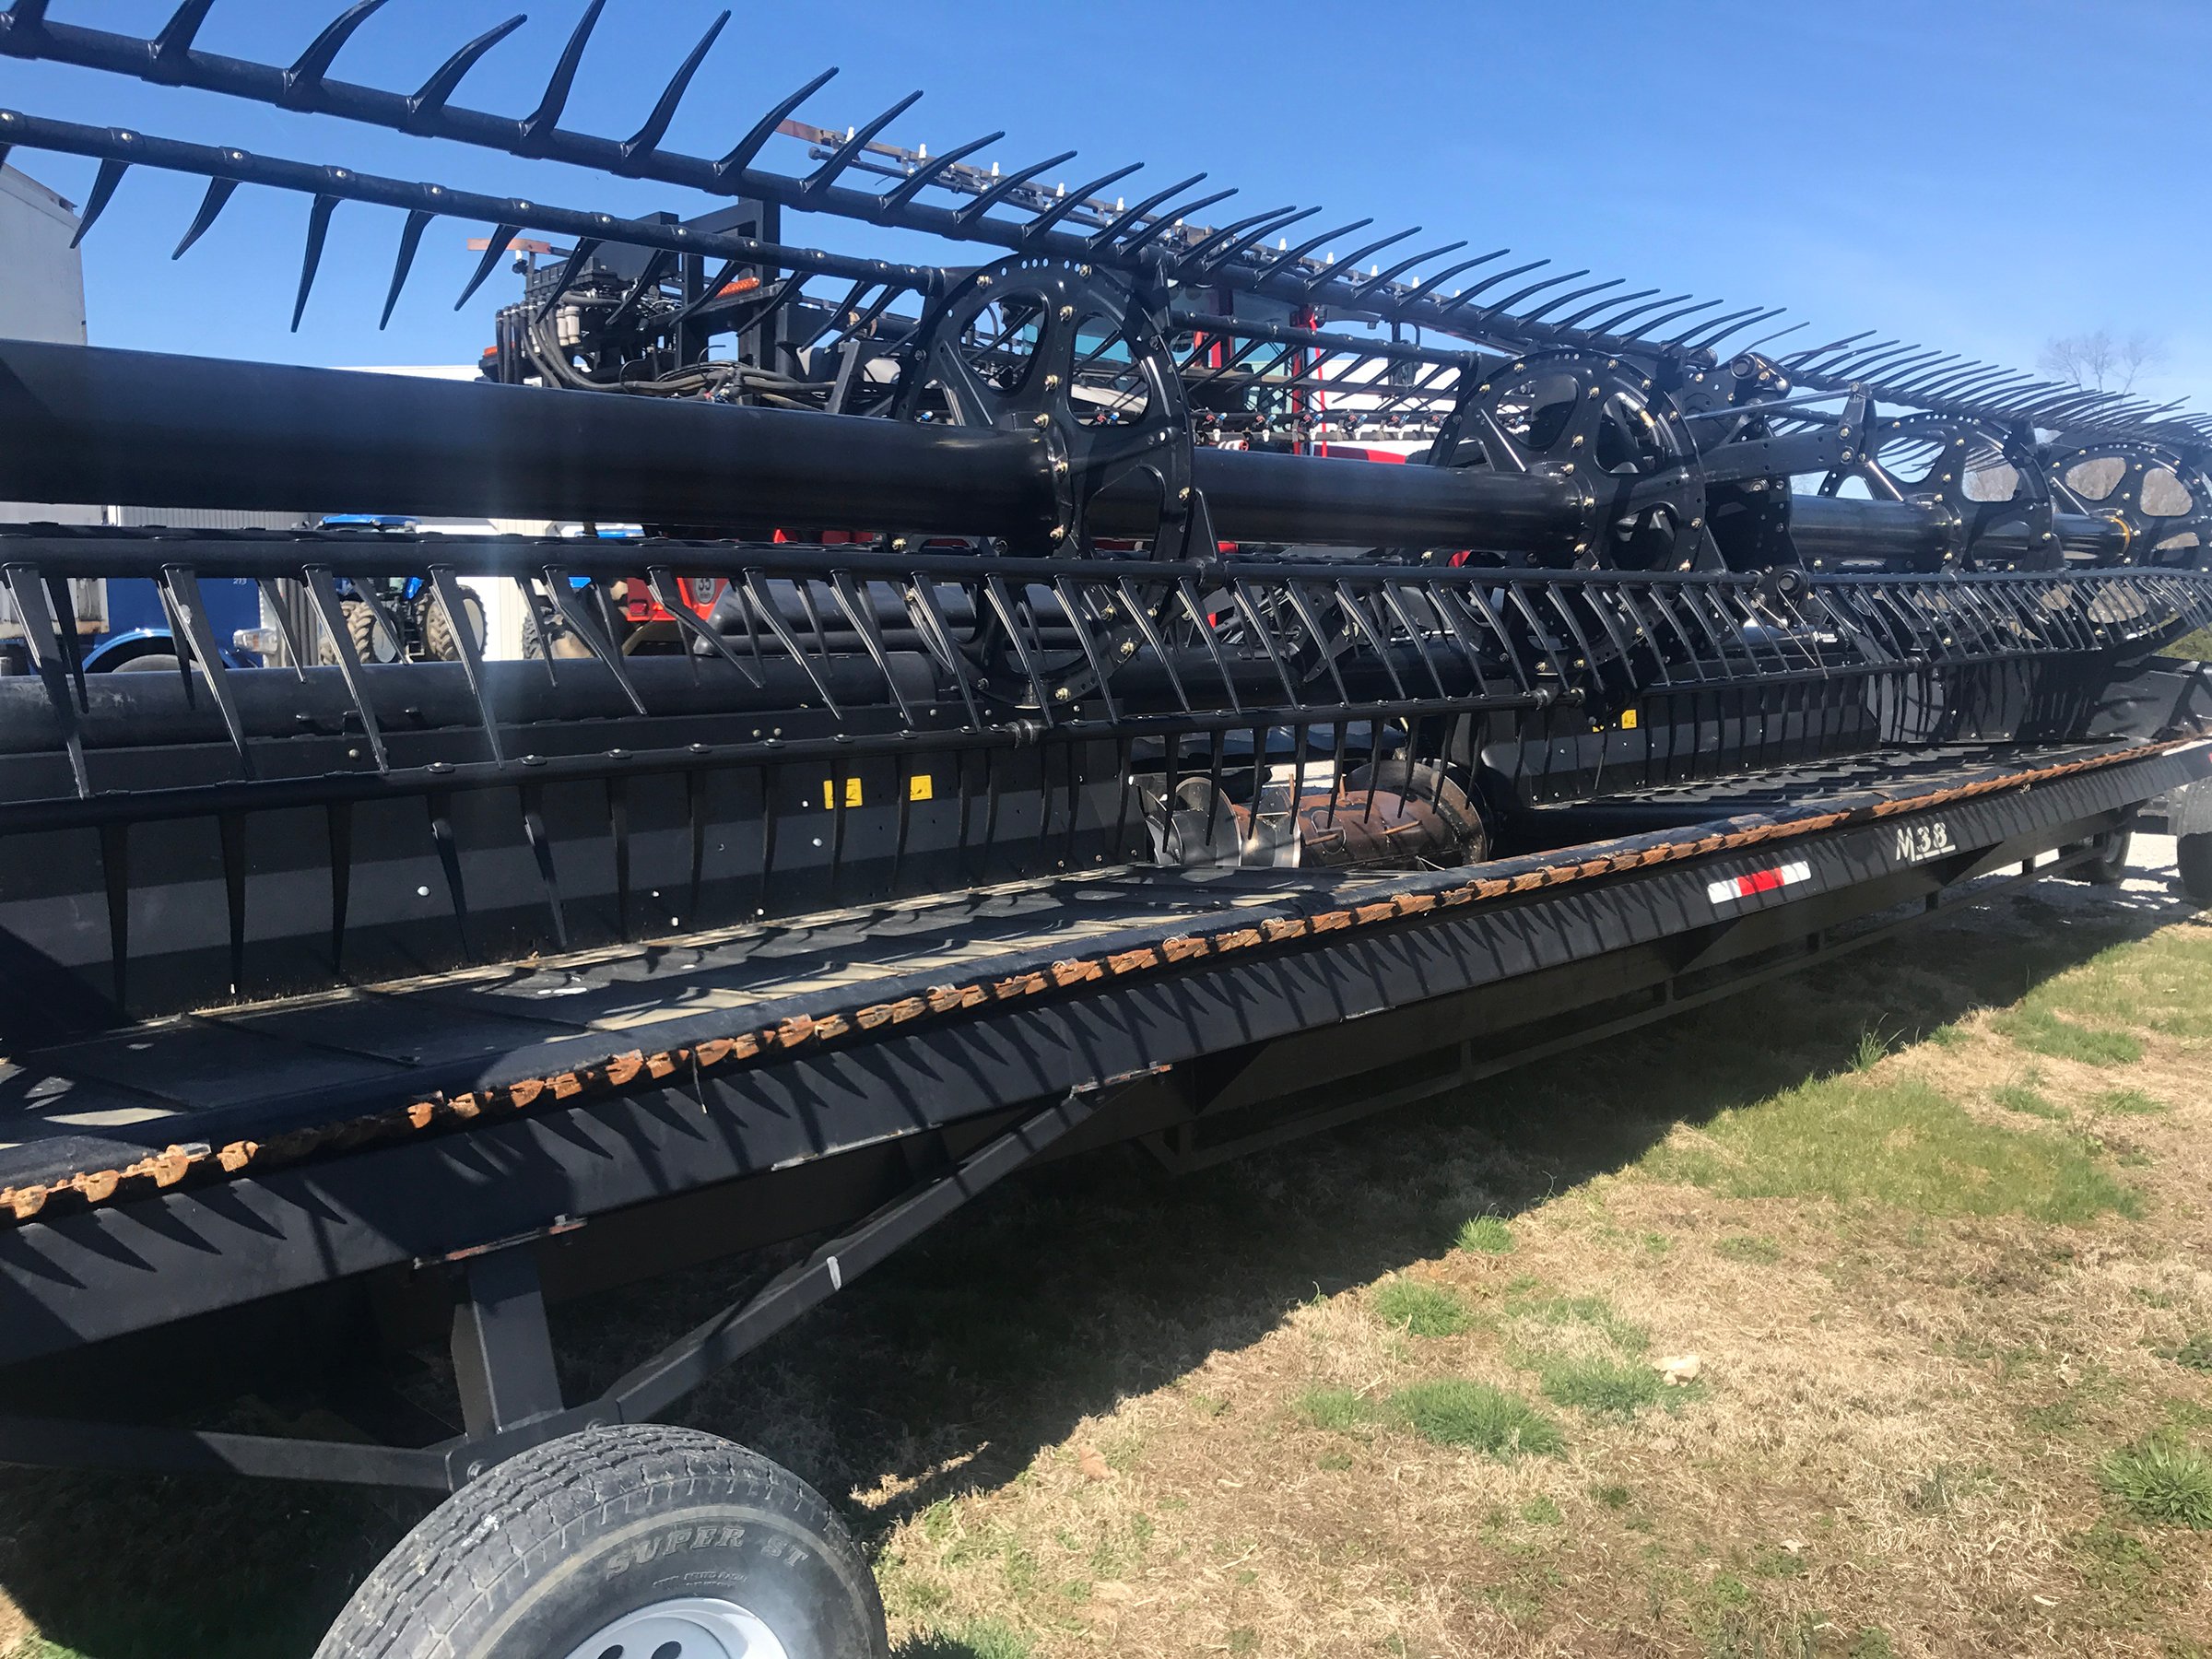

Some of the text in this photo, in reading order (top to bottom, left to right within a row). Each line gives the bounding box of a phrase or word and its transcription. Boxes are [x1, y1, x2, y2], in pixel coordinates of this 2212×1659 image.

[1896, 822, 1948, 862] M38
[606, 1525, 809, 1581] SUPER ST
